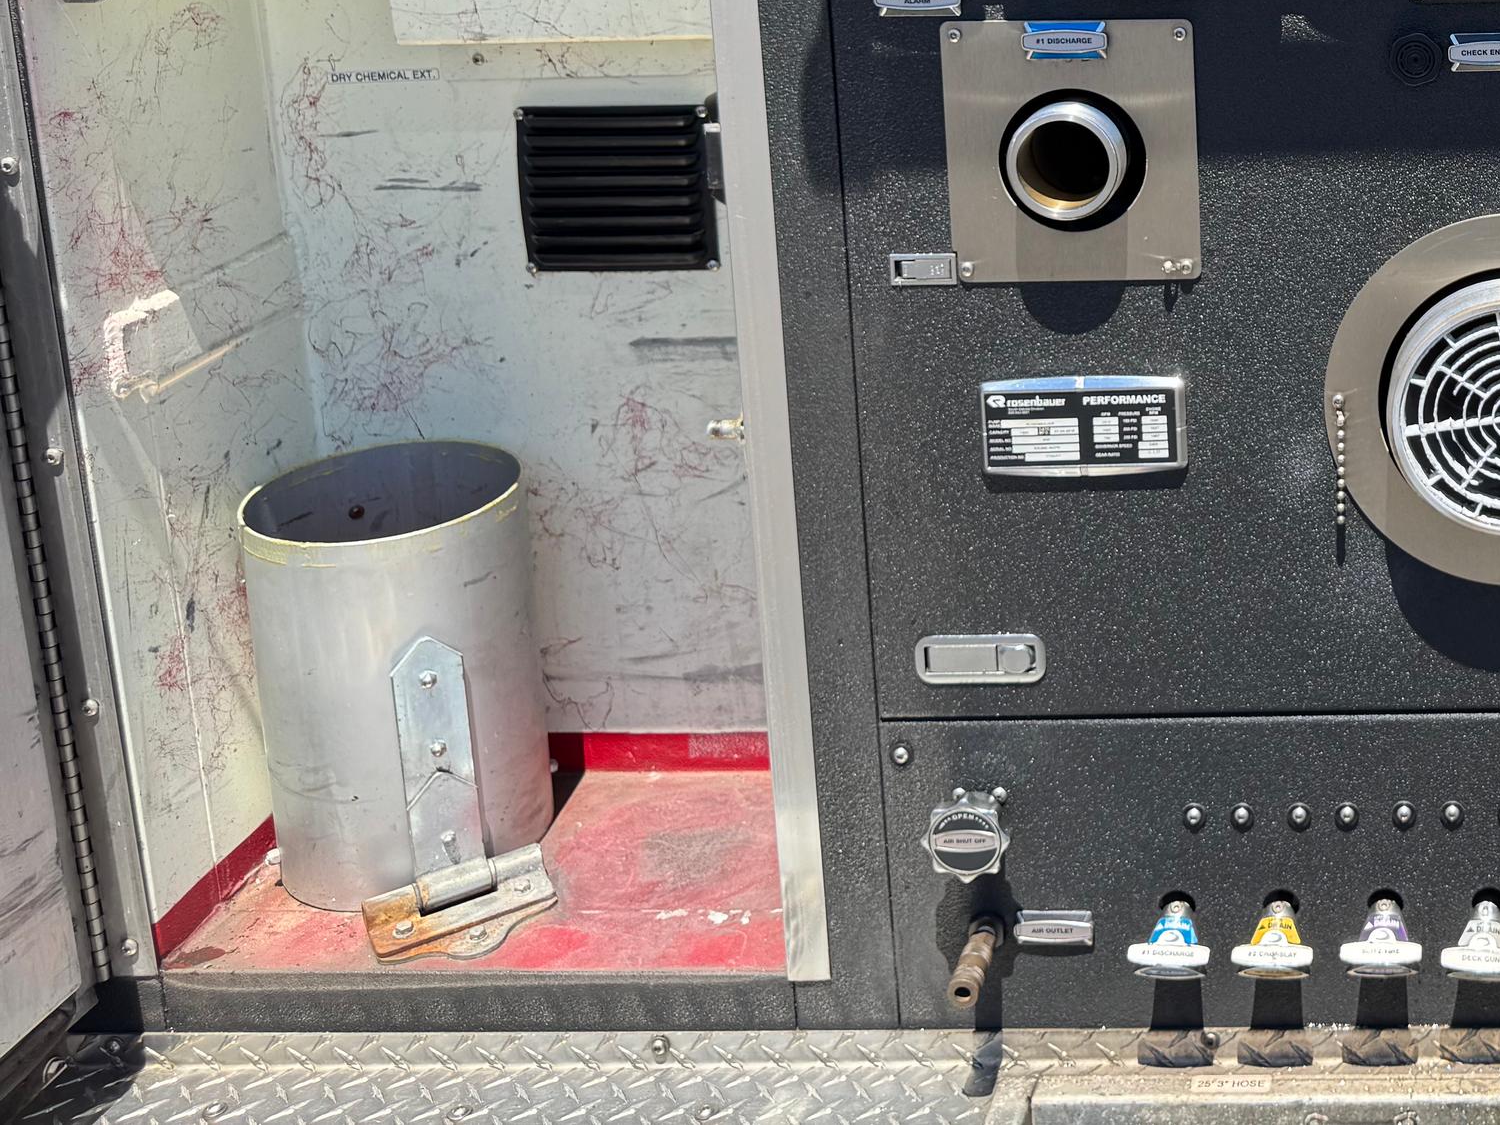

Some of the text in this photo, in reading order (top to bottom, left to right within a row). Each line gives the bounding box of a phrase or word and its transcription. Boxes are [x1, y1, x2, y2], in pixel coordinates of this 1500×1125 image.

[332, 70, 435, 82] DRY CHEMICAL EXT.
[1006, 396, 1065, 407] rosenbauer
[1083, 395, 1165, 405] PERFORMANCE
